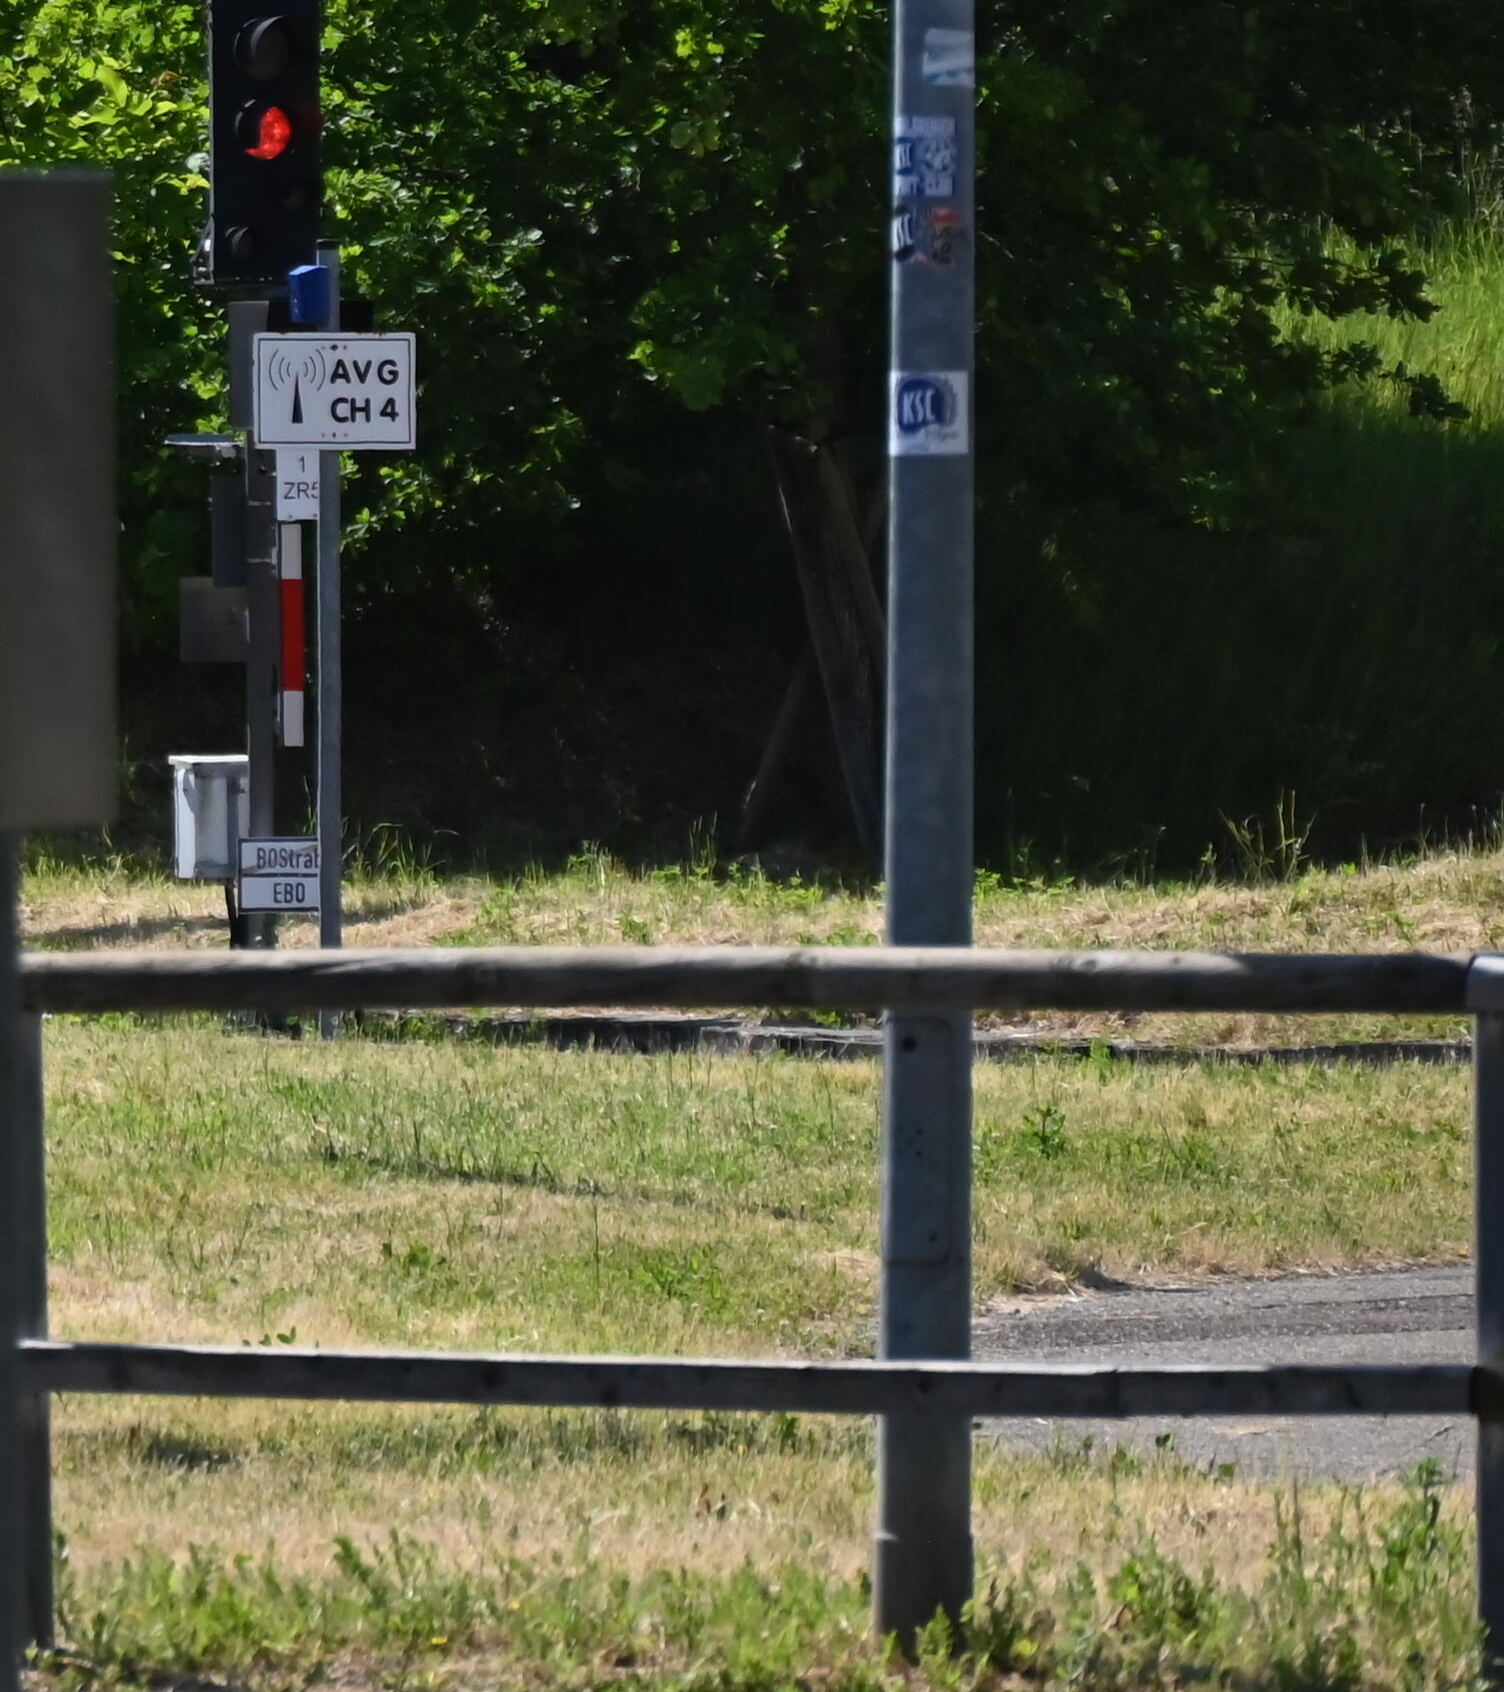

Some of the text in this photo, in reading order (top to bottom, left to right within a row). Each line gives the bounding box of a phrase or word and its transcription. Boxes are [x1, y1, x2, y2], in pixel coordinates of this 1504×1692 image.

[330, 359, 399, 385] AVG
[330, 397, 399, 423] CH 4
[298, 455, 306, 473] 1
[273, 882, 306, 904] EBO
